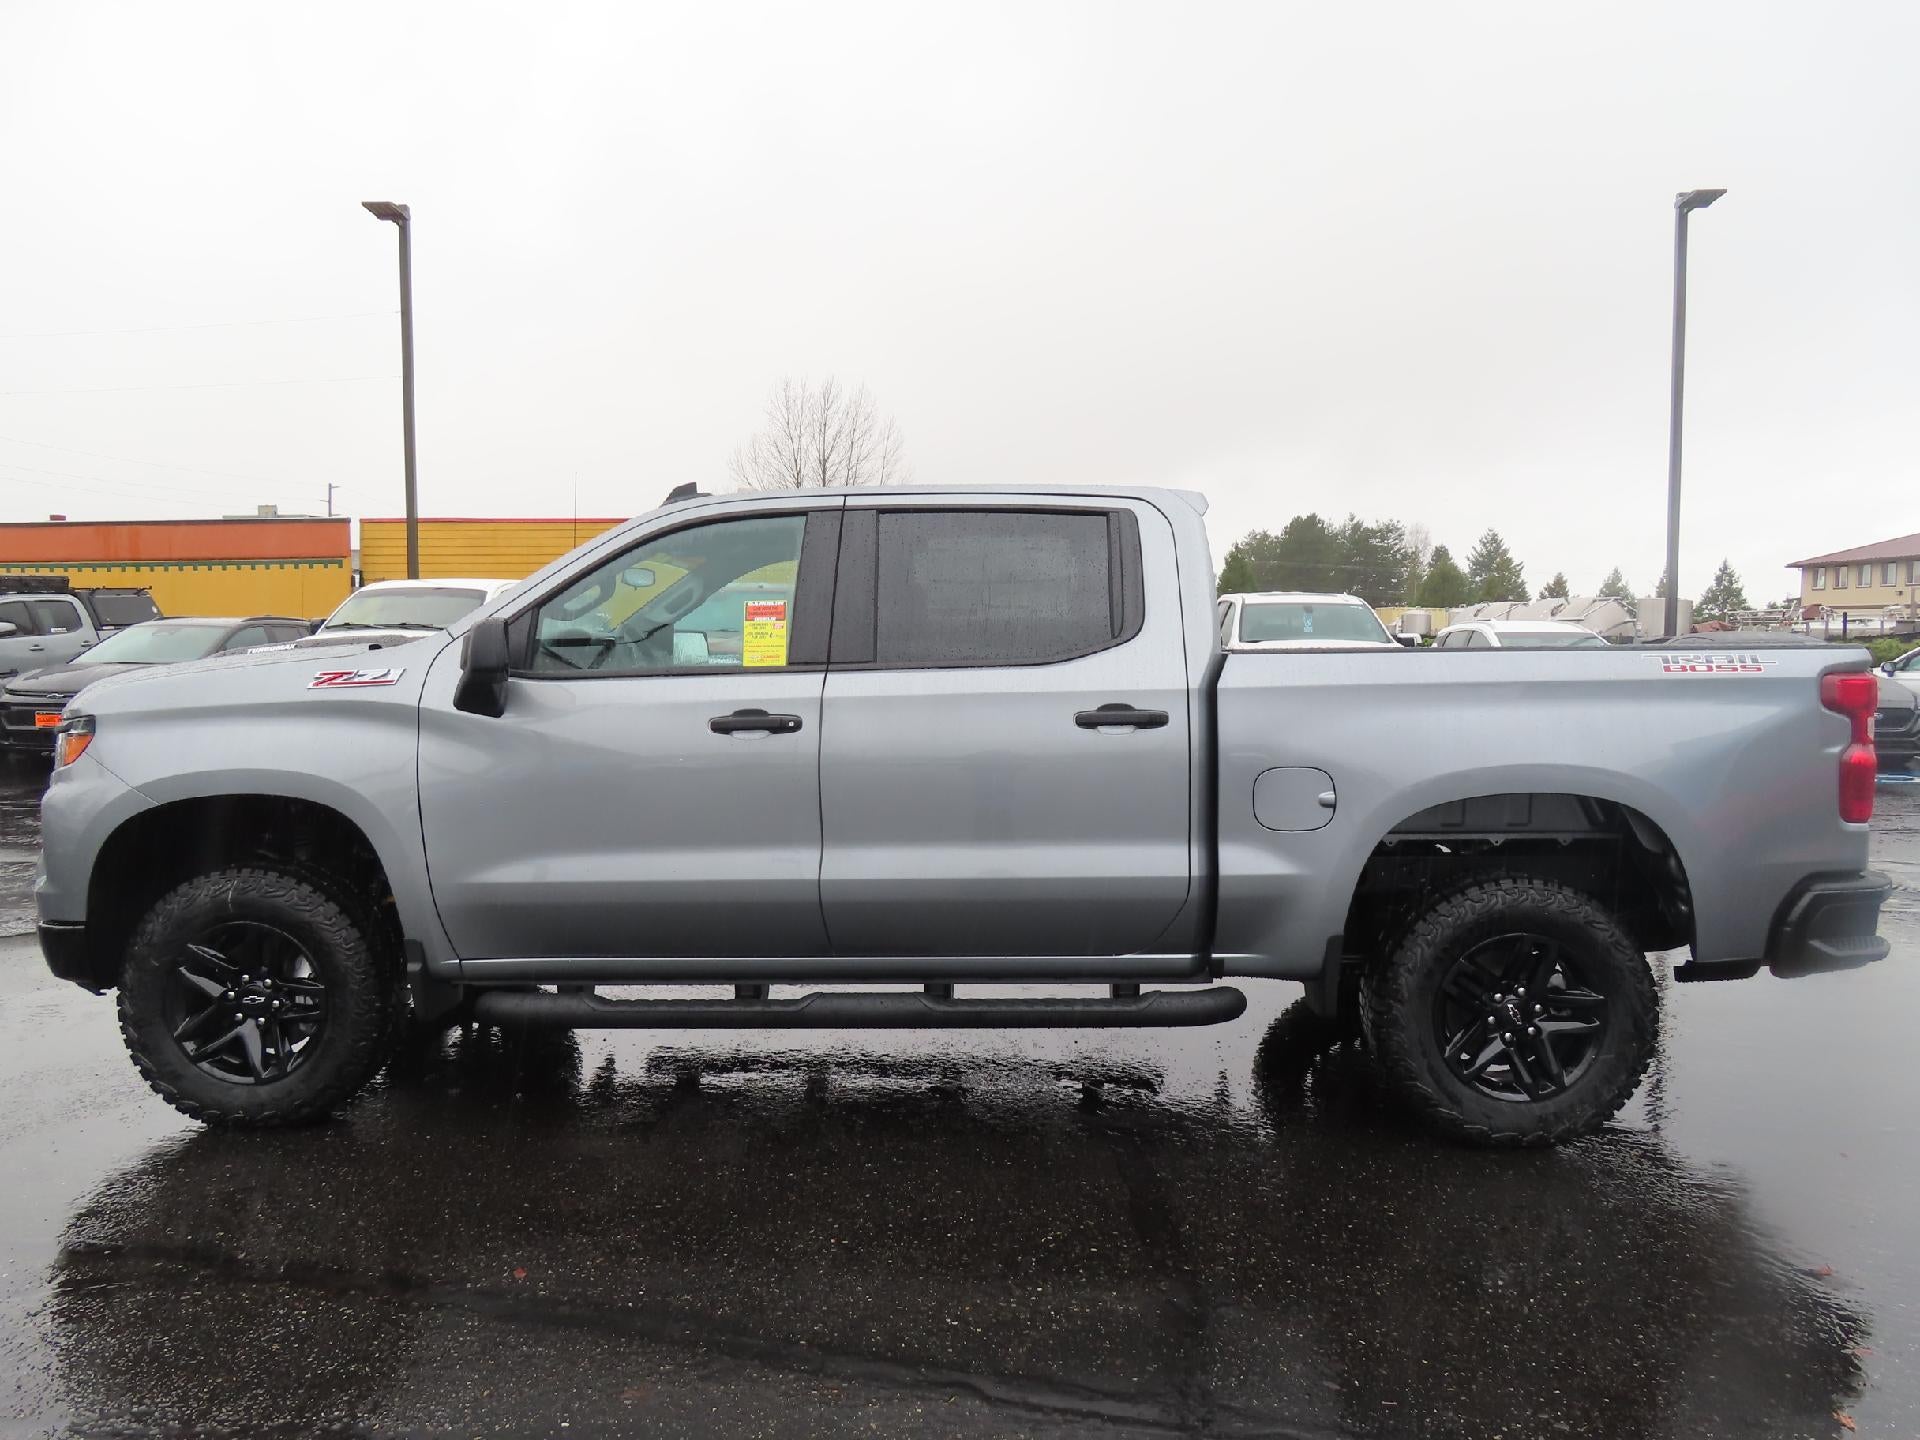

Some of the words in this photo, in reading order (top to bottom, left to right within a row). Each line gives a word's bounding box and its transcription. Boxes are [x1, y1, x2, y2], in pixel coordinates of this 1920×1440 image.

[1643, 653, 1777, 665] TRAIL
[1662, 664, 1764, 673] BOSS
[306, 668, 407, 689] Z71
